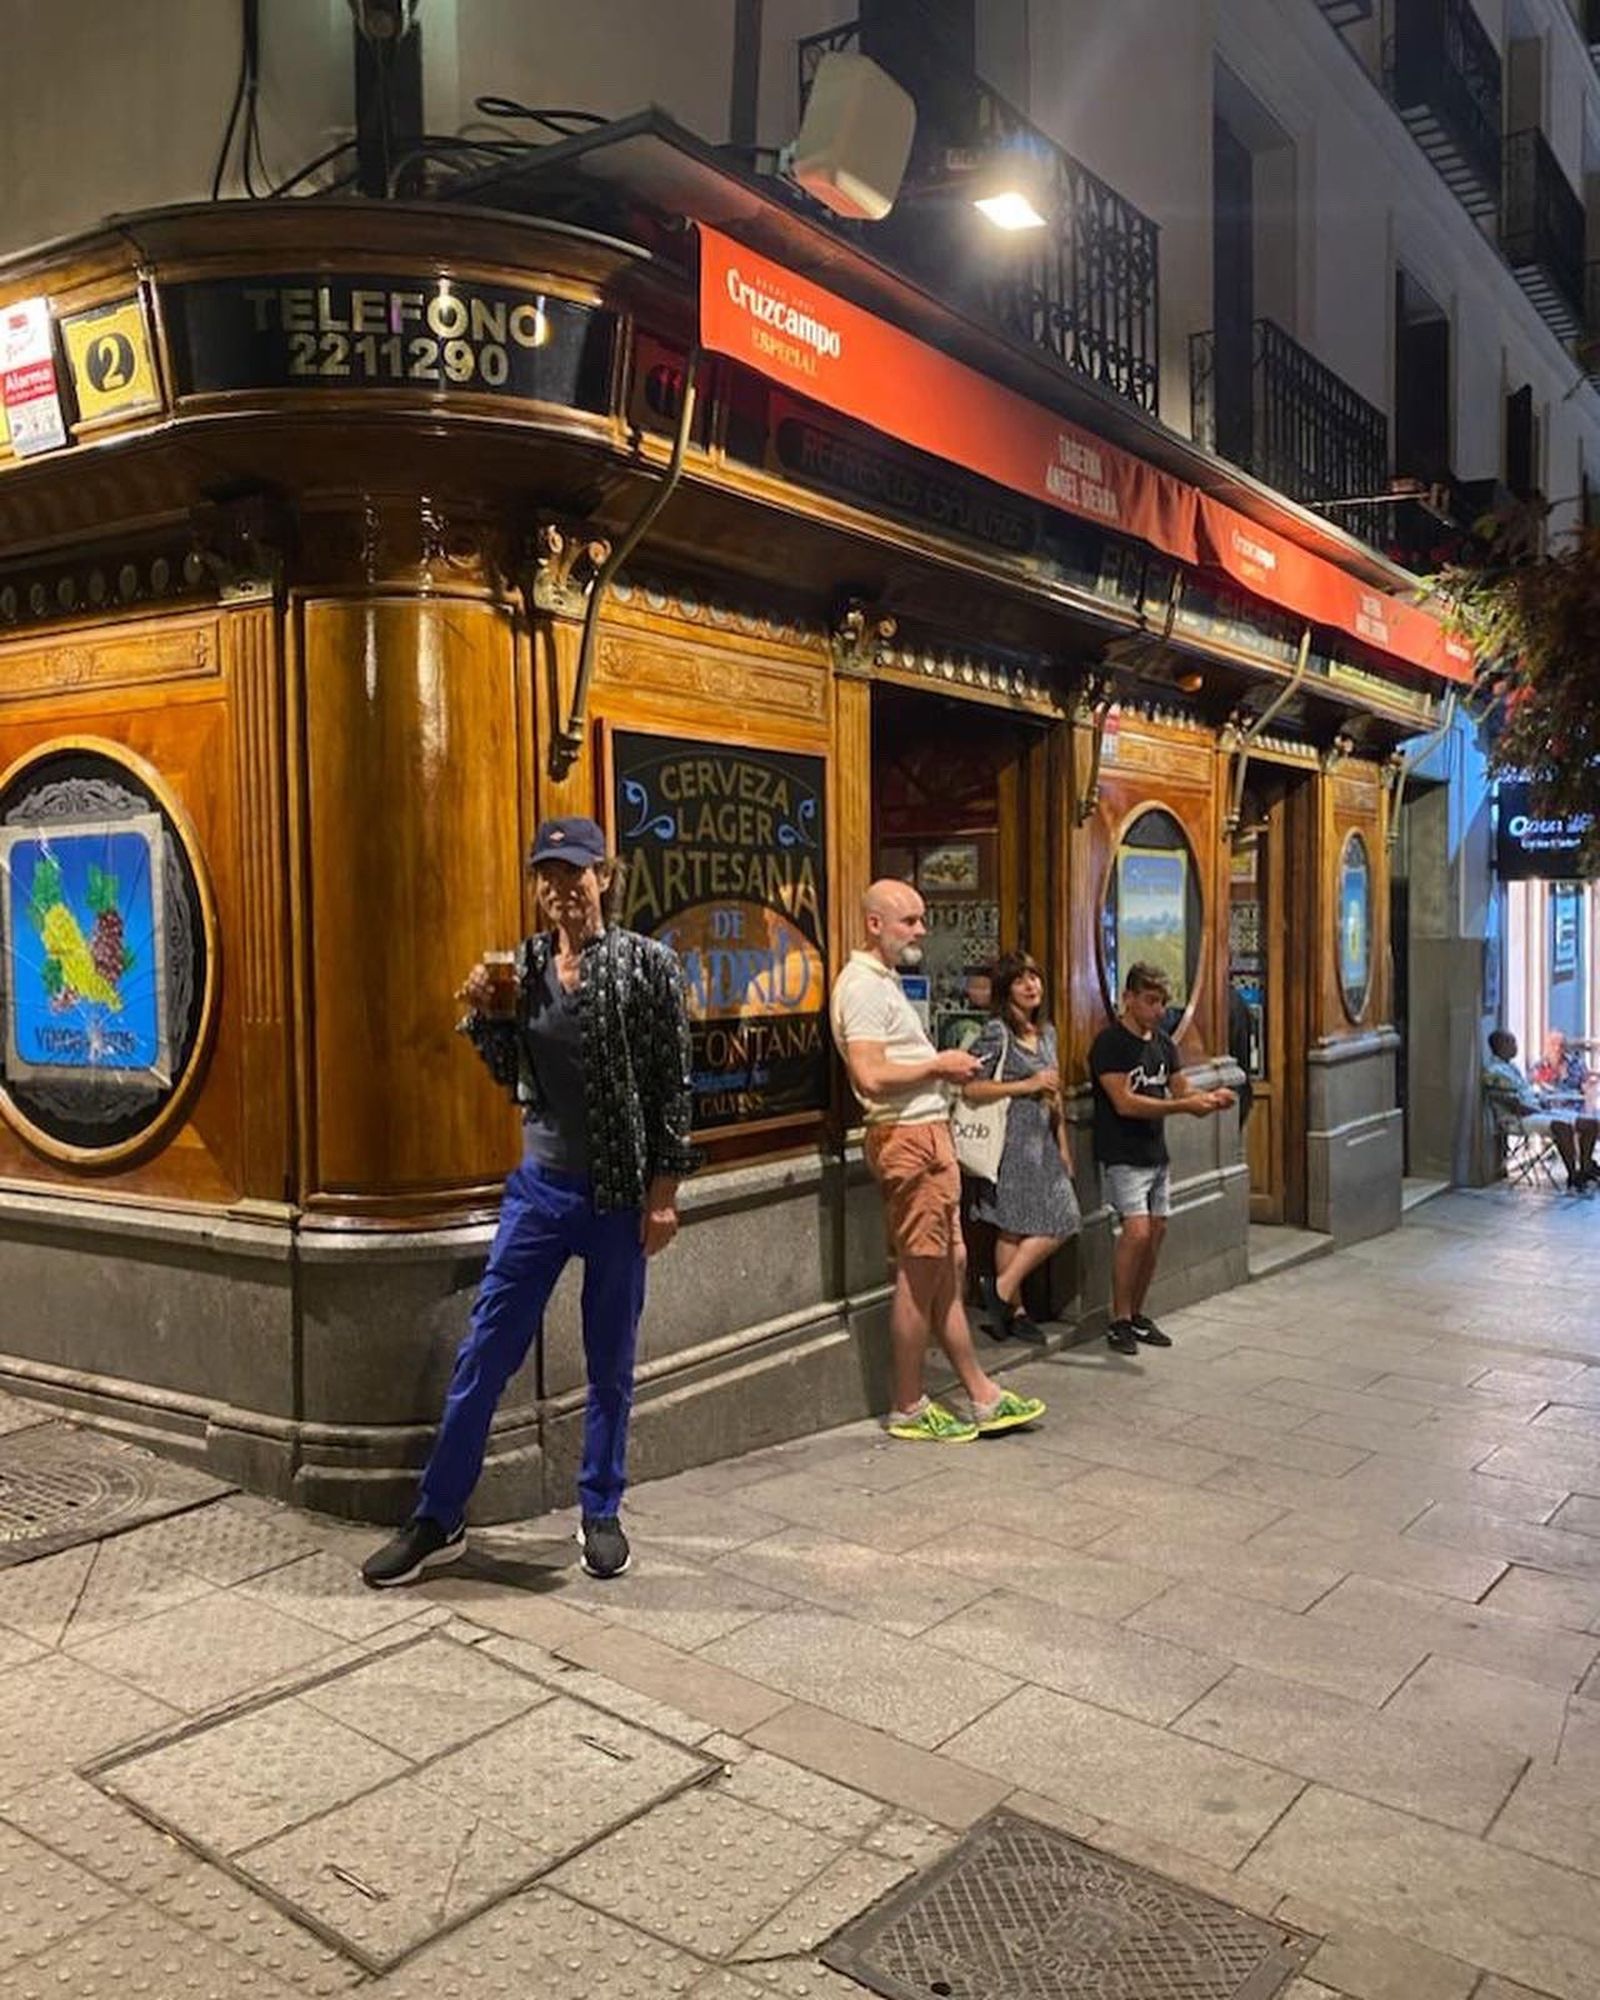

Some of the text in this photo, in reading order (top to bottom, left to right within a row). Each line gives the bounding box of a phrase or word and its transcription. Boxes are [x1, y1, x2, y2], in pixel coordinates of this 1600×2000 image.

[242, 286, 551, 348] TELEFONO
[726, 267, 841, 359] Cruzcampo
[98, 336, 125, 390] 2
[288, 332, 509, 386] 2211290
[659, 758, 791, 818] CERVEZA
[676, 801, 774, 847] LAGER
[623, 848, 827, 951] ARTESANA
[711, 909, 746, 941] DE
[691, 1021, 824, 1068] FONTANA
